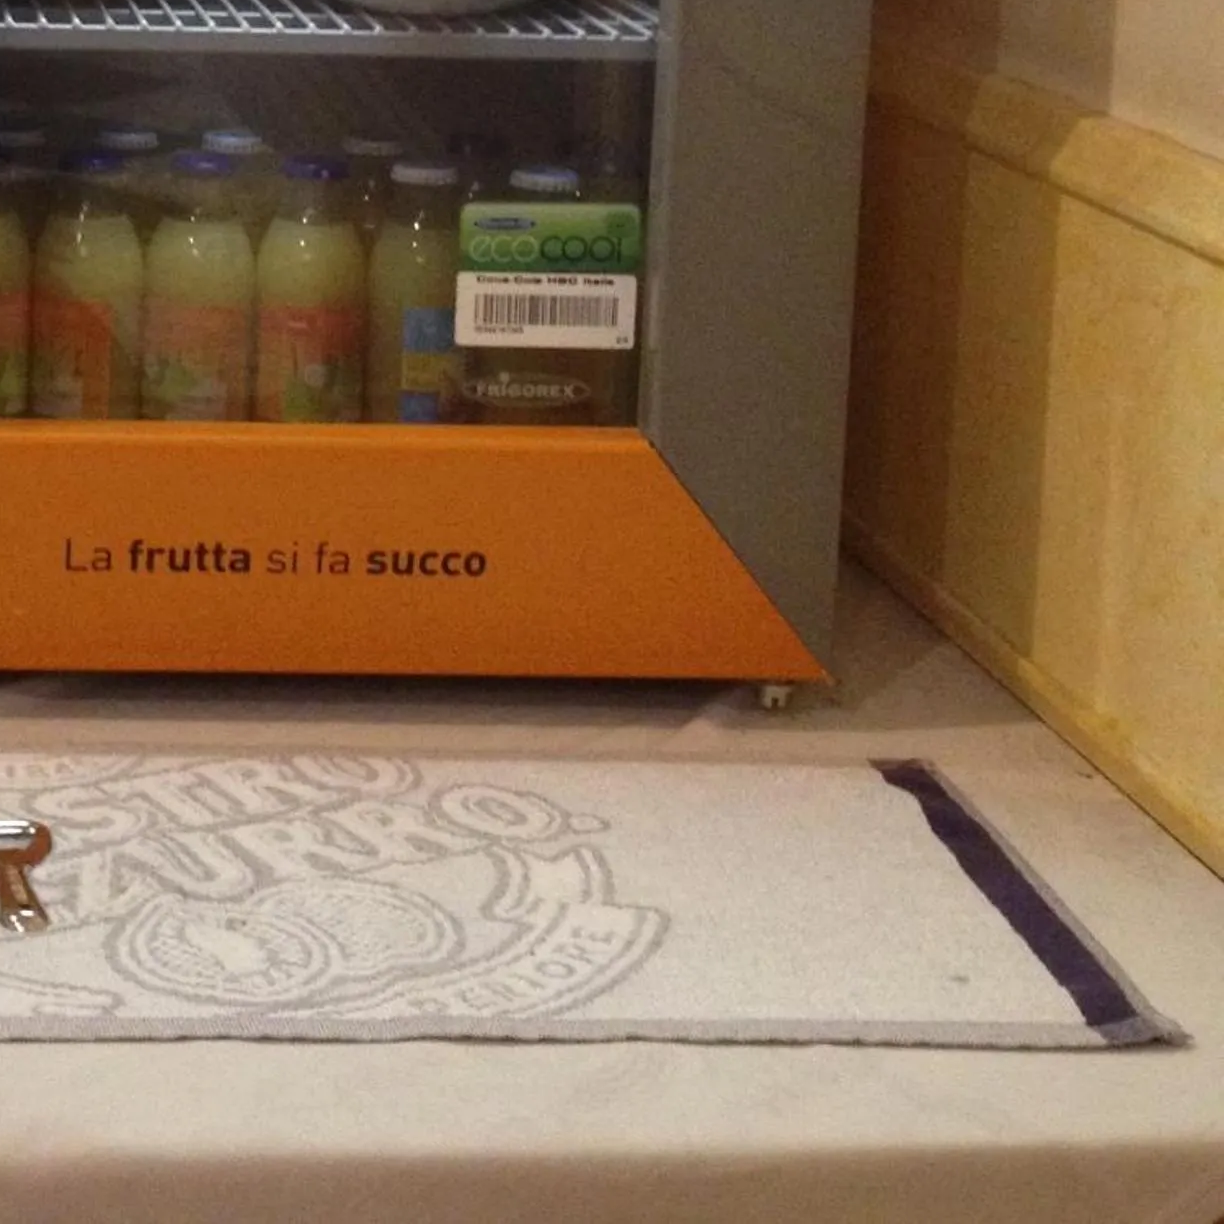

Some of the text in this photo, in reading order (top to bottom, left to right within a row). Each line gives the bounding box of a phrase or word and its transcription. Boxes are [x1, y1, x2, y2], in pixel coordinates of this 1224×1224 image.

[64, 538, 487, 577] La frutta si fa succo
